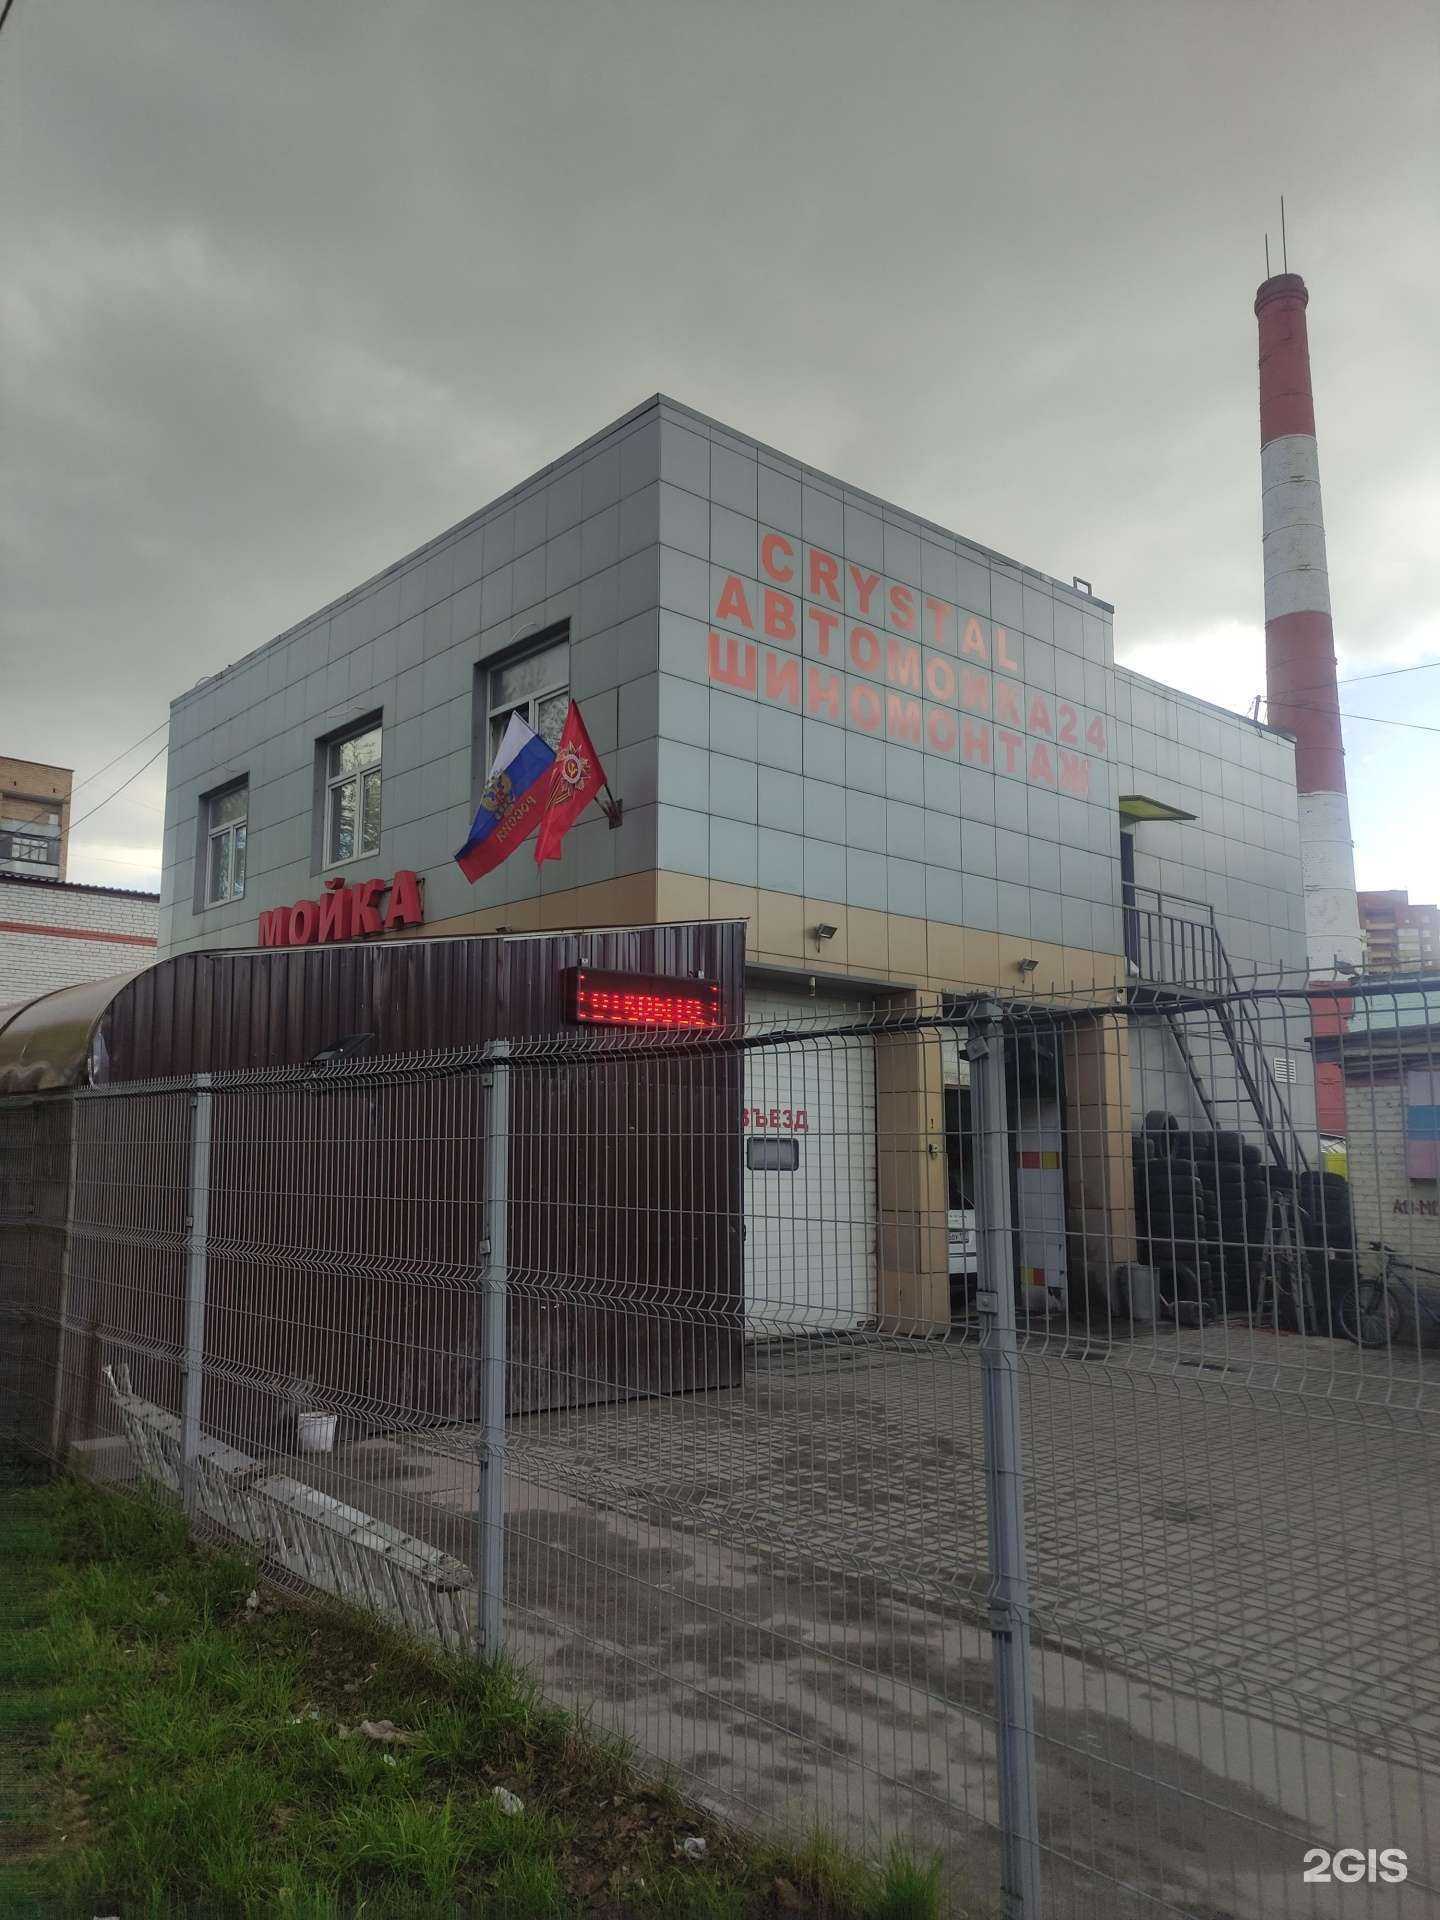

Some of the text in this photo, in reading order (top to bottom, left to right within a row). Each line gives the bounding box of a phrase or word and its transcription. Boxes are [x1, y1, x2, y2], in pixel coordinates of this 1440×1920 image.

[761, 533, 1018, 673] CRYSTAL
[708, 631, 1089, 794] ШИНОМОНТАЖ
[258, 870, 424, 946] МОЙКА
